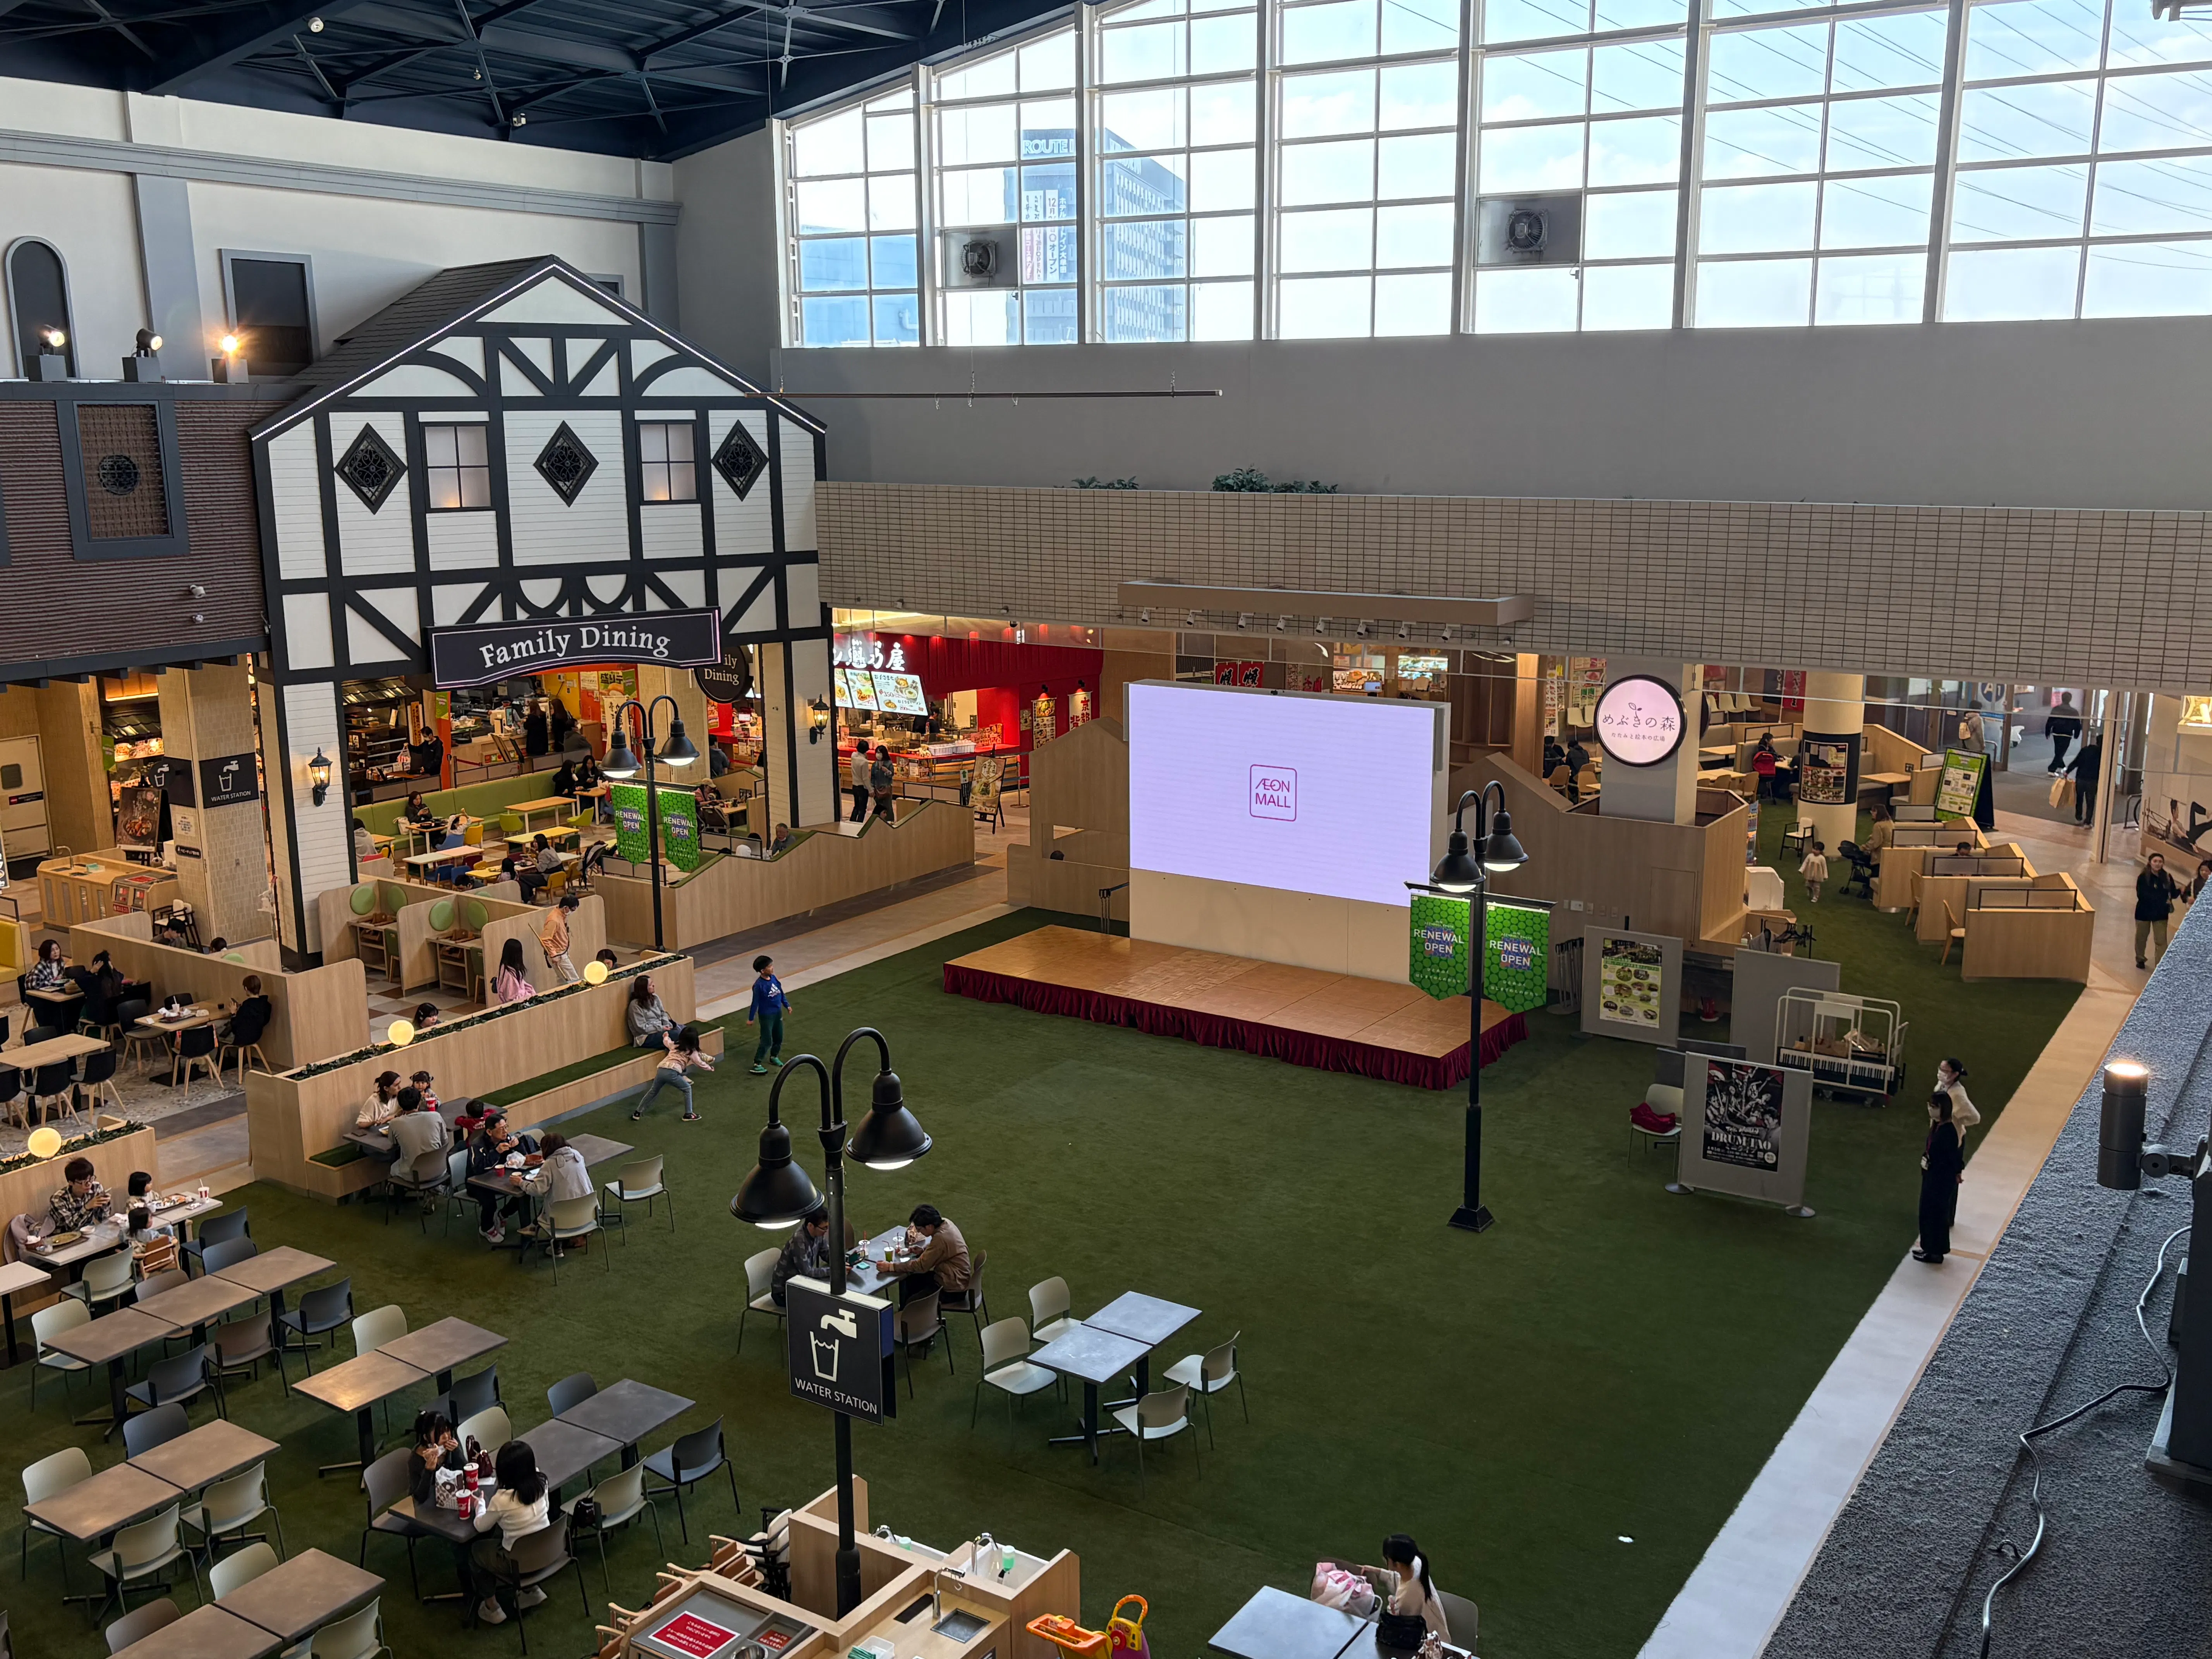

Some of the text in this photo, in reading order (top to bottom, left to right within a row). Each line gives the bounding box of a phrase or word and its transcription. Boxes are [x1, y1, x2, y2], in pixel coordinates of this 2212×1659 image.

[1023, 139, 1068, 154] ROUTE
[479, 625, 670, 668] Family Dining
[723, 654, 737, 669] ily
[705, 668, 739, 685] Dining
[1603, 713, 1675, 732] めぶきの森
[211, 790, 251, 802] WATER STATION
[1255, 793, 1291, 808] MALL
[616, 810, 646, 822] RENEWAL
[663, 816, 695, 828] RENEWAL
[623, 821, 640, 830] OPEN
[672, 827, 689, 836] OPEN
[1414, 929, 1465, 944] RENEWAL
[1425, 943, 1453, 954] OPEN
[1490, 940, 1543, 956] RENEWAL
[1501, 954, 1530, 966] OPEN
[1711, 1131, 1771, 1150] DRUM TAO
[795, 1377, 877, 1414] WATER STATION
